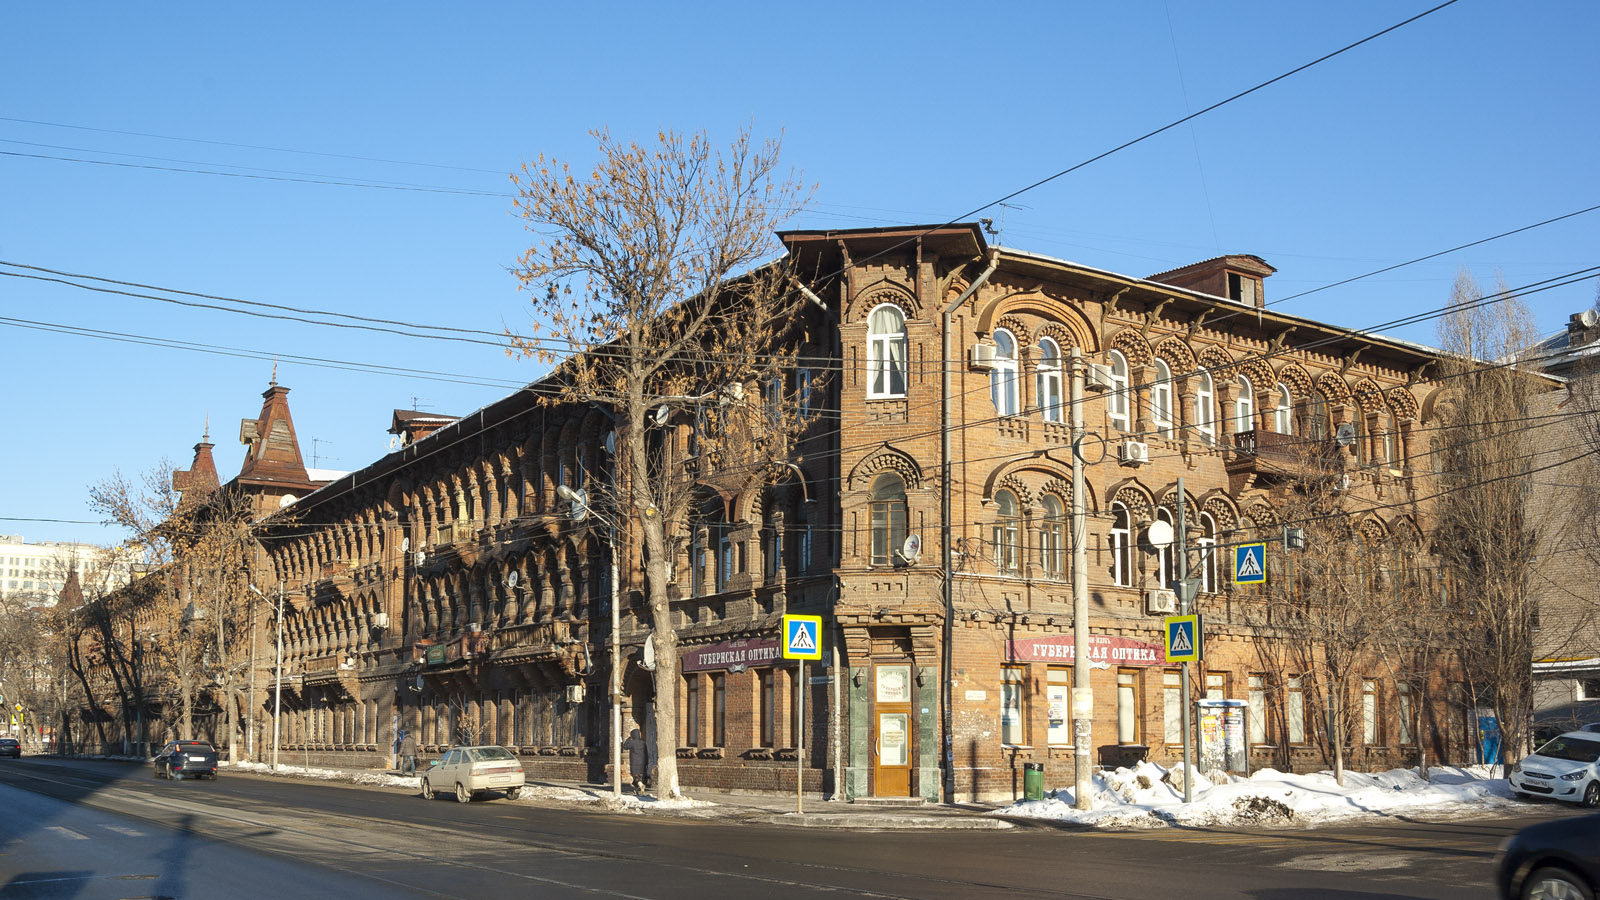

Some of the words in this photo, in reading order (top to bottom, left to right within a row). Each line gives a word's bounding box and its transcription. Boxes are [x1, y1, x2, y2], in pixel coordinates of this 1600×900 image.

[698, 650, 746, 665] ГУБЕРНСКАЯ
[748, 646, 781, 661] ОПТИКА
[1112, 647, 1157, 661] ОПТИКА
